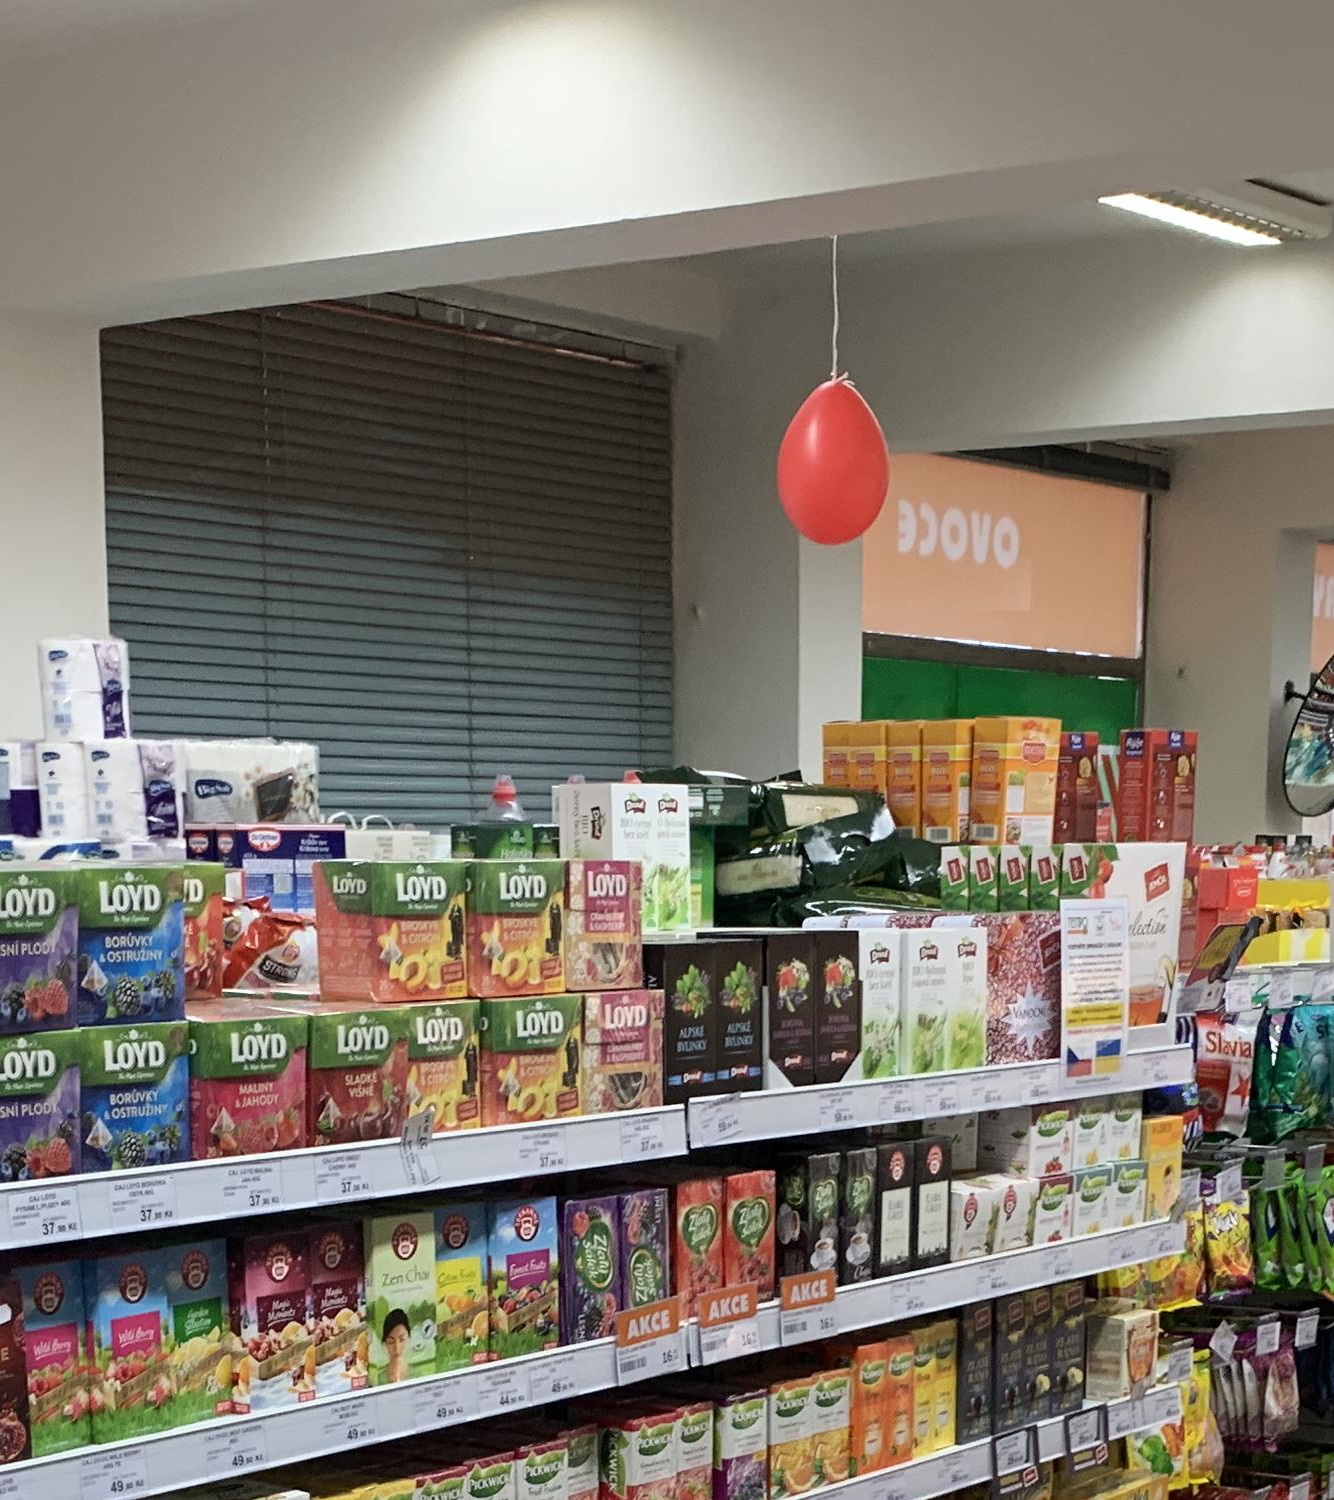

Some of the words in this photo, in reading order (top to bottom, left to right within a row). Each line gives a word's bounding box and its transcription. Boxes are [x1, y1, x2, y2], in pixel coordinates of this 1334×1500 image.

[262, 959, 300, 981] STRONG
[516, 1010, 564, 1039] LOYD
[605, 1003, 647, 1029] LOYD
[337, 1023, 390, 1055] LOYD
[417, 1016, 463, 1046] LOYD
[1205, 1030, 1252, 1057] Slavia
[105, 1039, 165, 1074] LOYD
[231, 1032, 287, 1063] LOYD
[109, 1090, 158, 1105] BORŮVKY
[239, 1083, 273, 1095] MALINY
[243, 1095, 279, 1108] JAHODY
[382, 1271, 403, 1286] Zen
[790, 1280, 828, 1303] AKCE
[709, 1294, 749, 1320] AKCE
[627, 1310, 670, 1339] AKCE
[638, 1430, 673, 1448] PICKWICK
